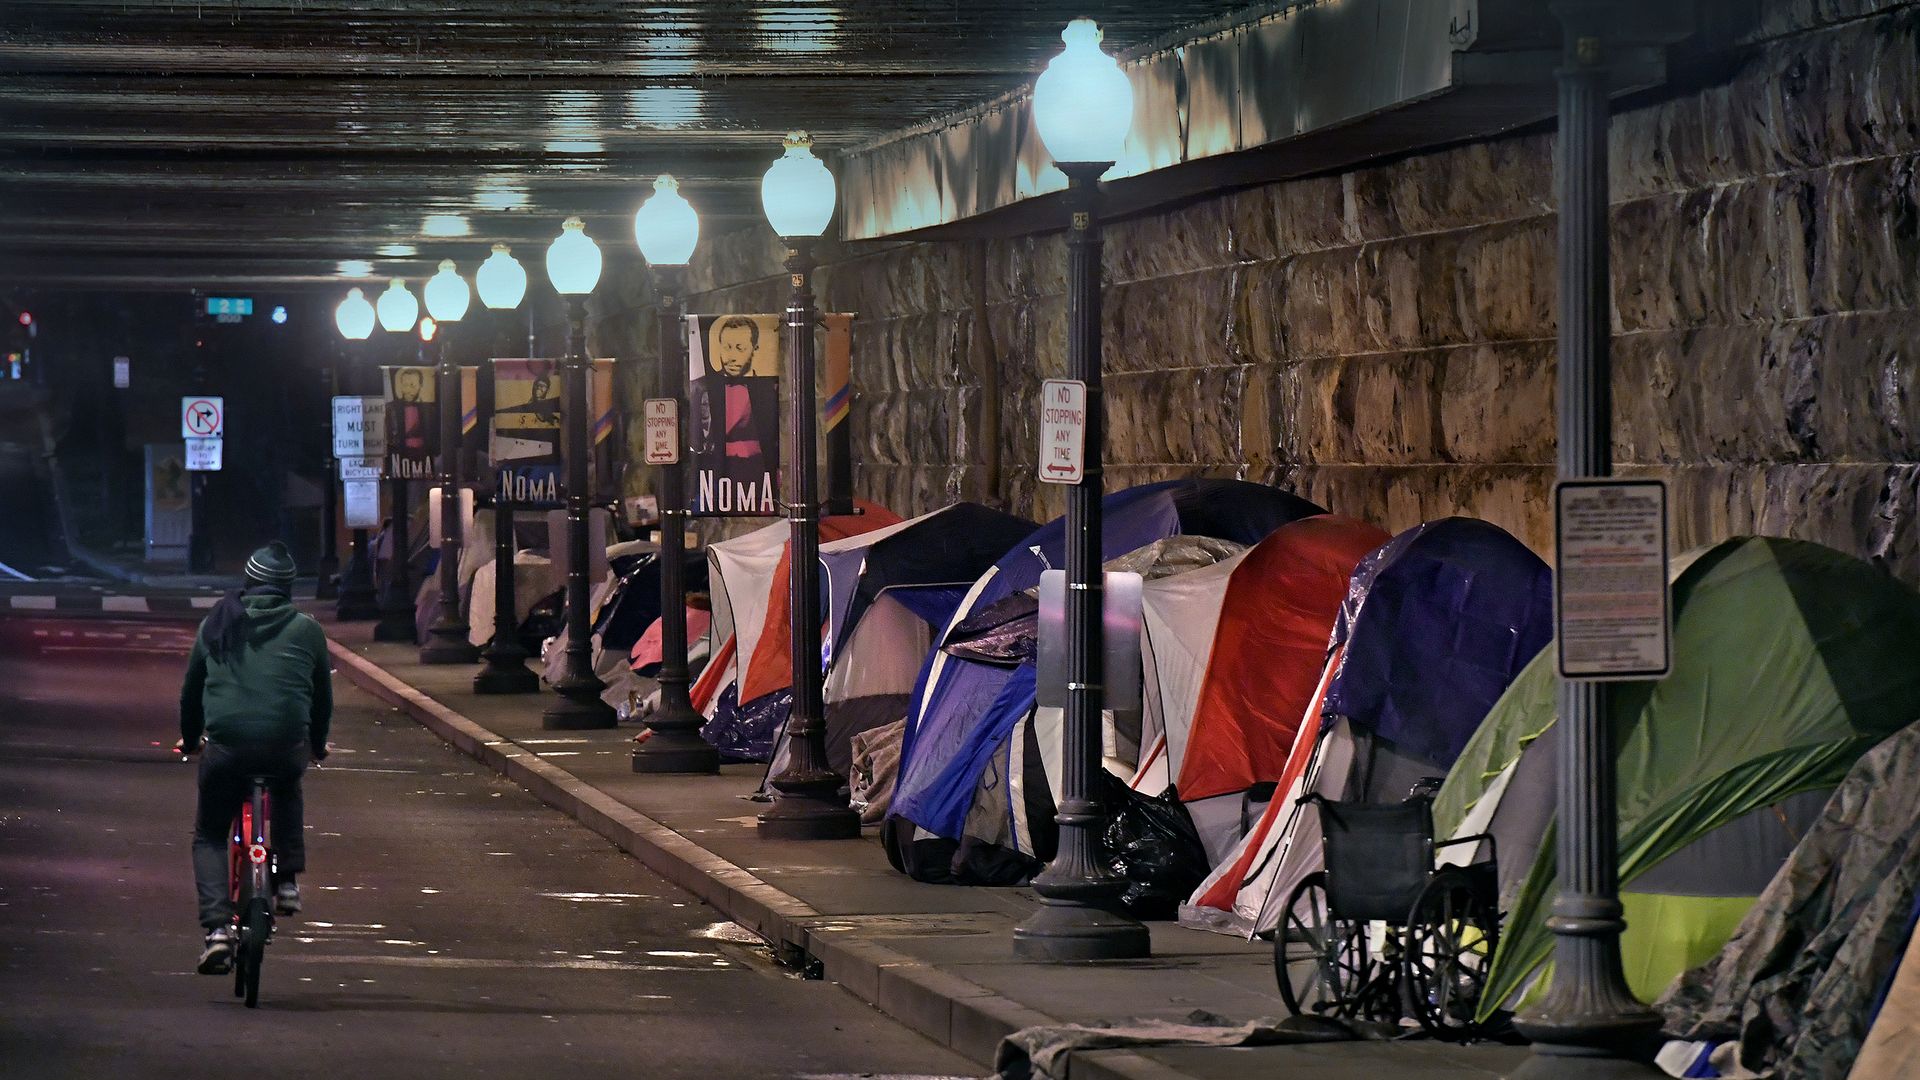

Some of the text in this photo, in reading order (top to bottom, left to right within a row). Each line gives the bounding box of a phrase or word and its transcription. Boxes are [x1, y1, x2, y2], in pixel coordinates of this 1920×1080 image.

[792, 275, 803, 286] 25
[1057, 387, 1070, 403] NO
[337, 405, 361, 414] RIGHT
[655, 403, 666, 414] NO
[647, 416, 676, 427] STOPPING
[1045, 408, 1082, 425] STOPPING
[347, 421, 376, 432] MUST
[656, 430, 667, 439] ANY
[1055, 430, 1071, 442] ANY
[338, 439, 360, 449] TURN
[655, 441, 668, 451] TIME
[1054, 447, 1071, 460] TIME
